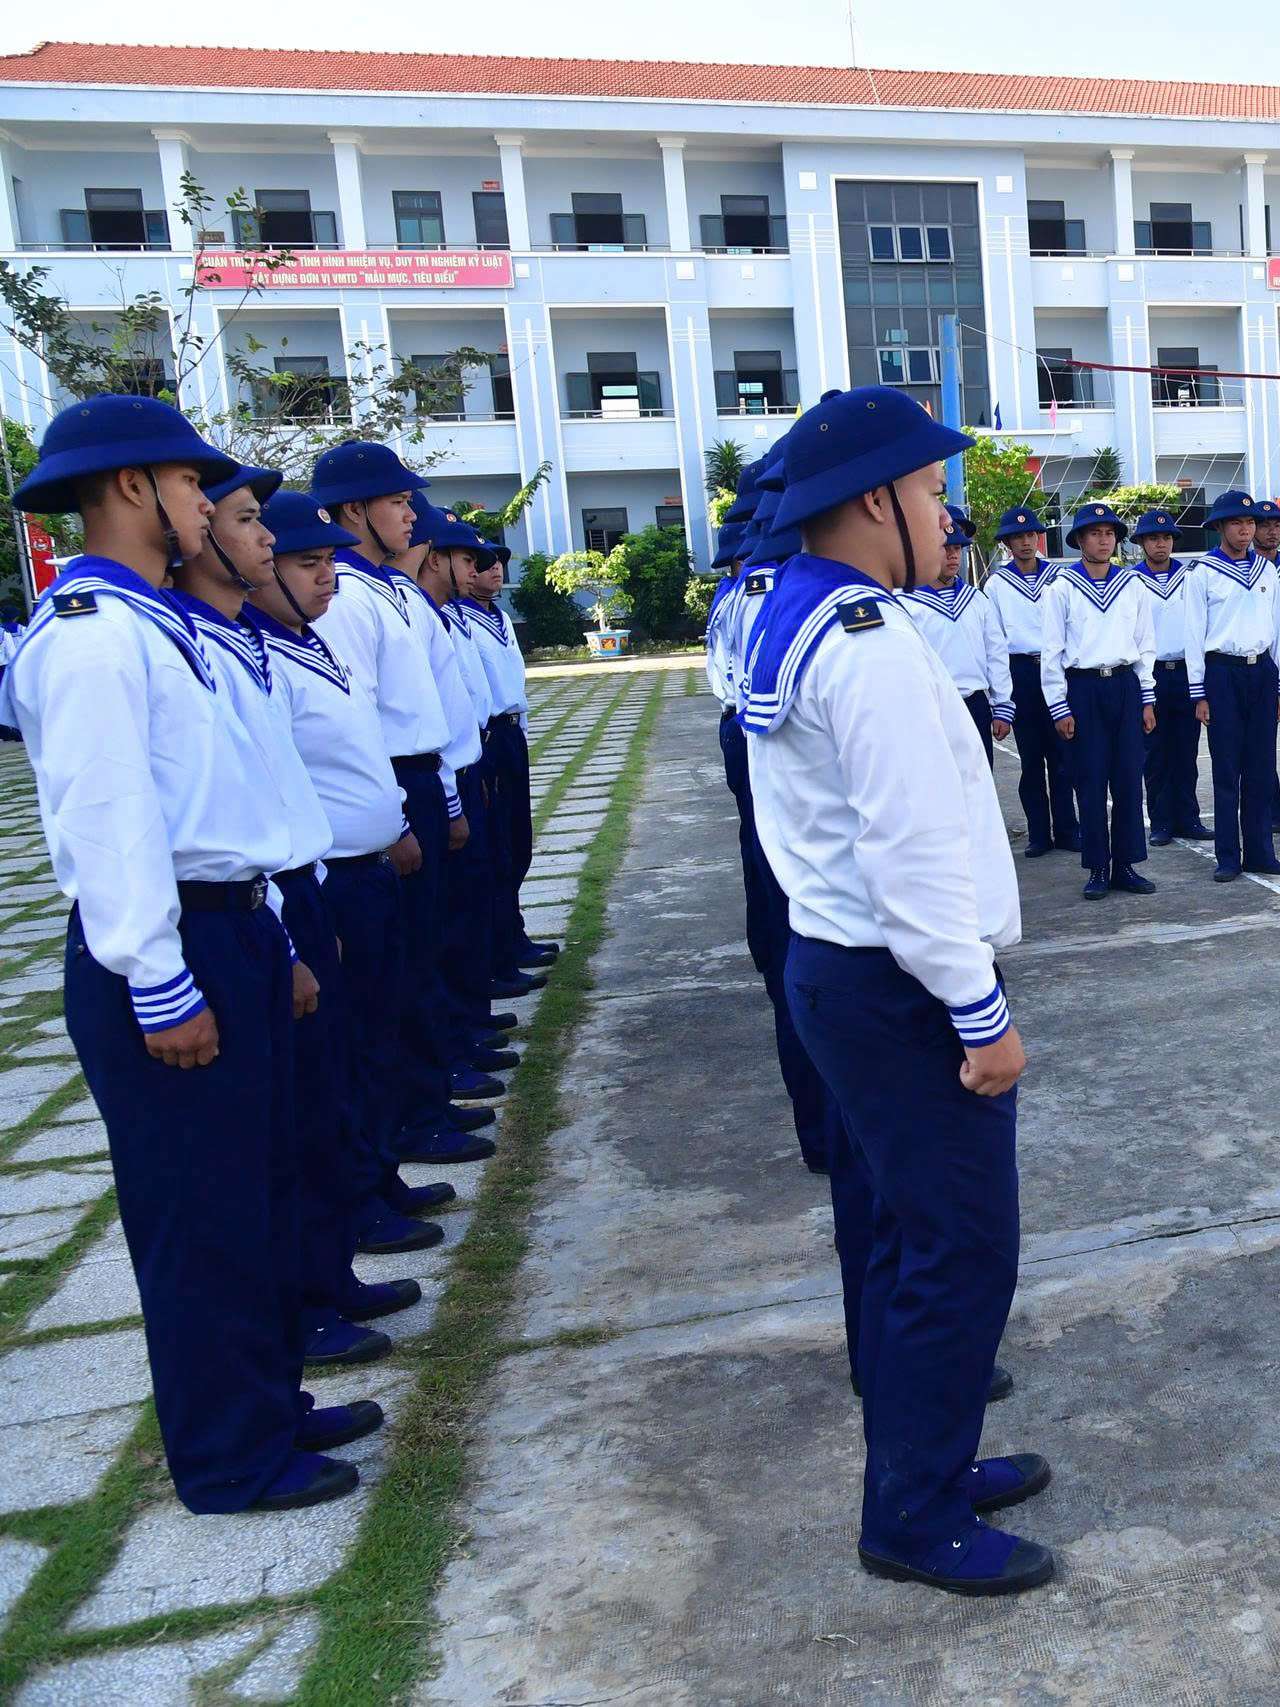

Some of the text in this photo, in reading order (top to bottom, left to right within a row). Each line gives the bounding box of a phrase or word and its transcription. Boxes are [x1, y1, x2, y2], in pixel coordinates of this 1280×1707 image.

[301, 256, 320, 267] TÌNH
[323, 256, 344, 267] HÌNH
[347, 255, 376, 268] NHIỆM
[396, 256, 412, 267] DUY
[432, 255, 466, 267] NGHIÊM
[482, 255, 503, 268] LUẬT
[273, 273, 297, 286] DỰNG
[413, 271, 432, 283] TIÊU
